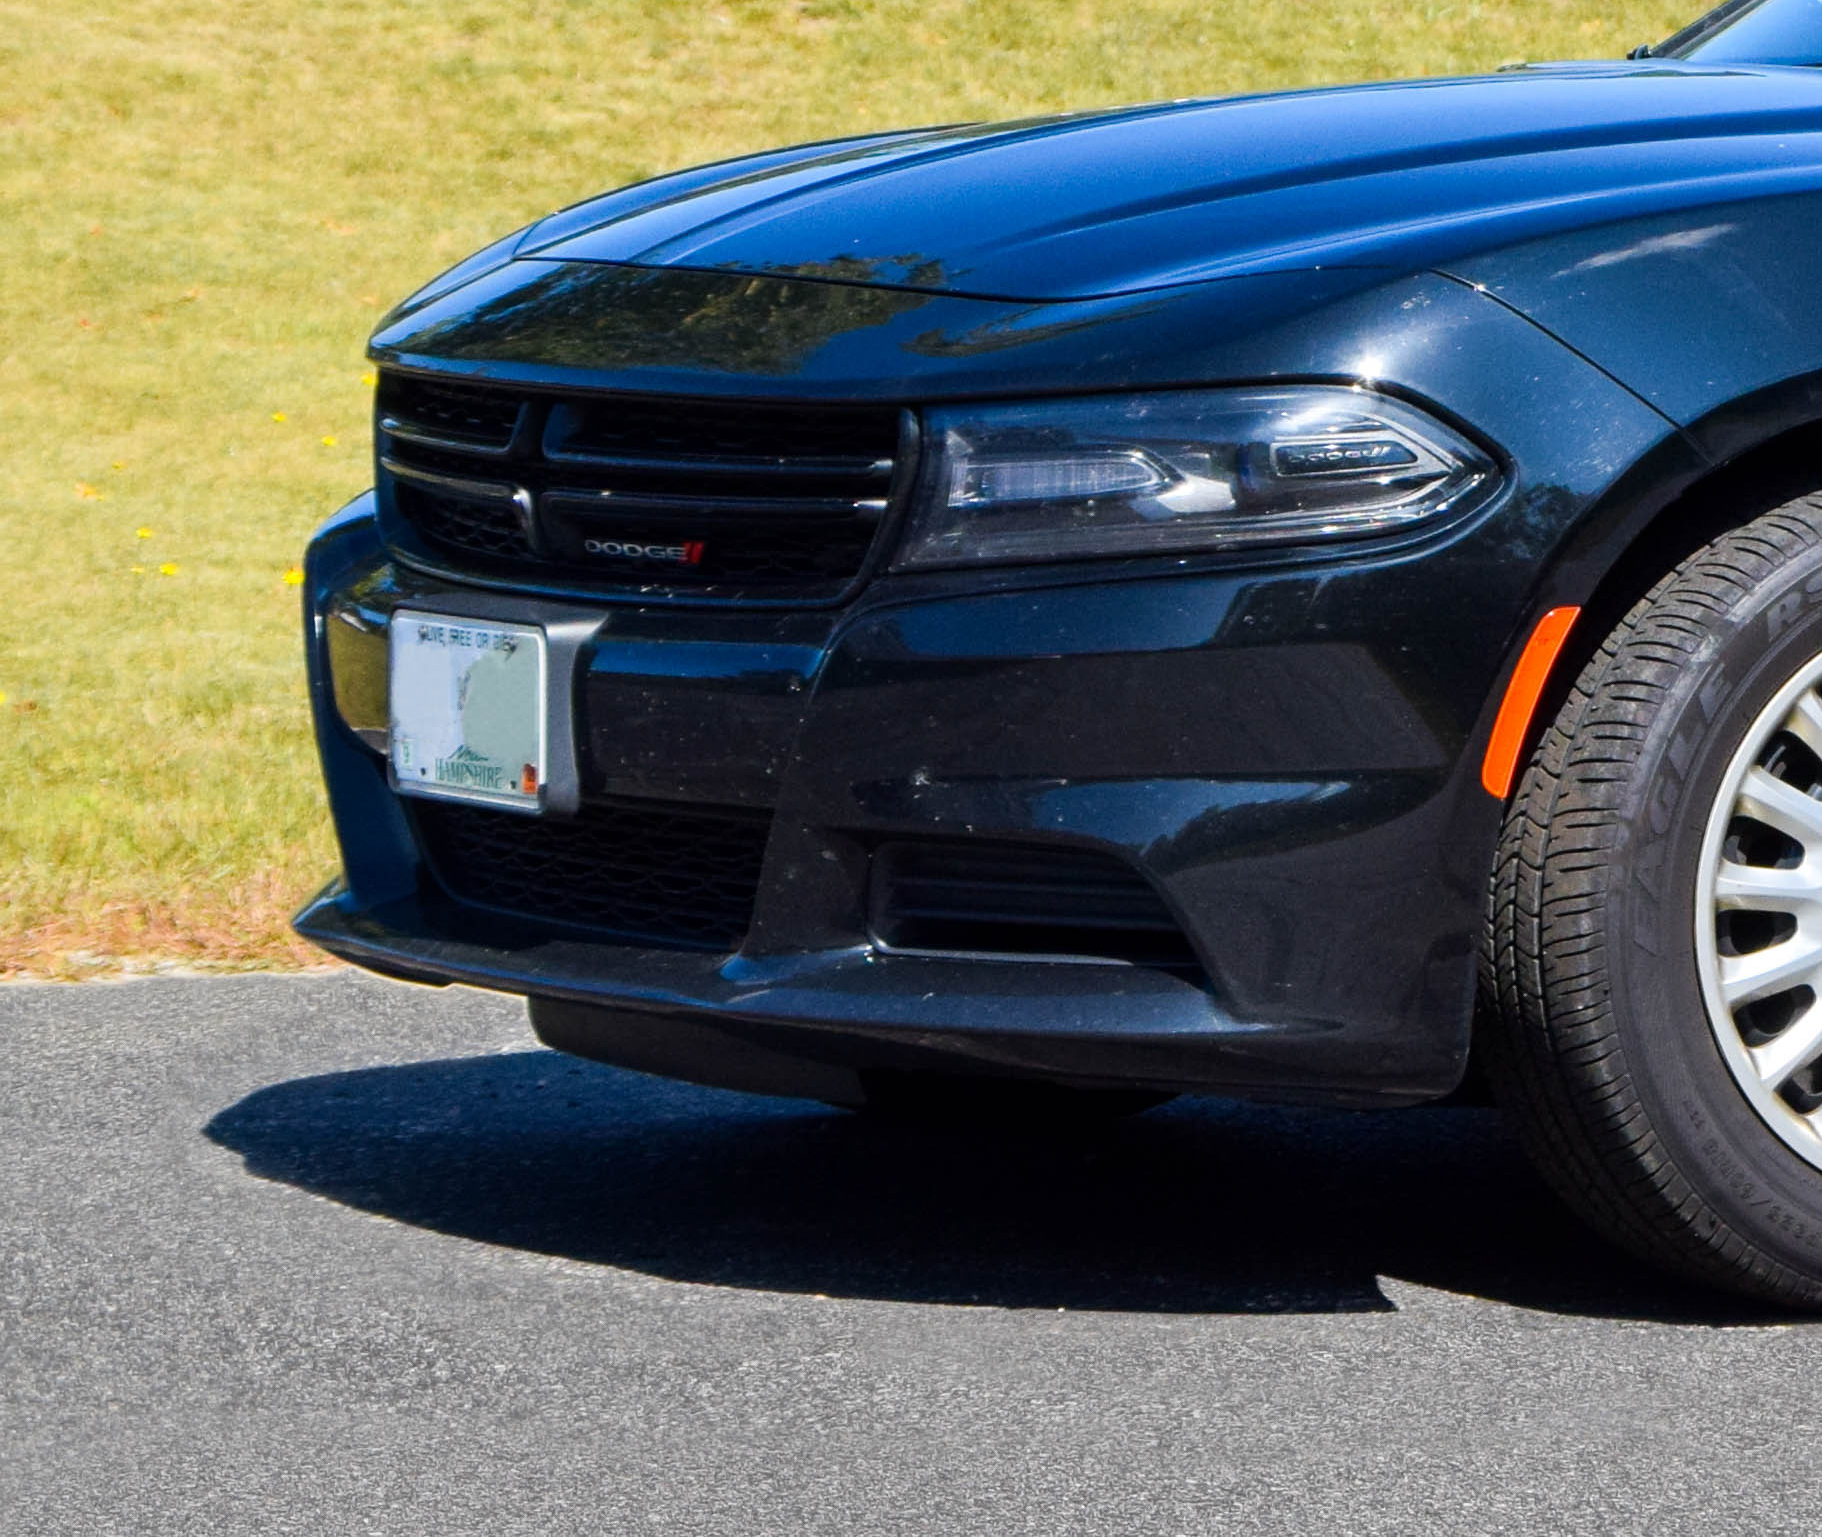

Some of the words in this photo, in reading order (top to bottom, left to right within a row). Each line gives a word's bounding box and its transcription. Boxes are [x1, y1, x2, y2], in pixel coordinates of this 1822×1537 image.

[585, 539, 688, 561] DODGE
[449, 628, 472, 647] FREE
[476, 631, 489, 649] OR
[435, 758, 504, 789] HAMPSHIRE
[1630, 662, 1734, 960] EAGLE
